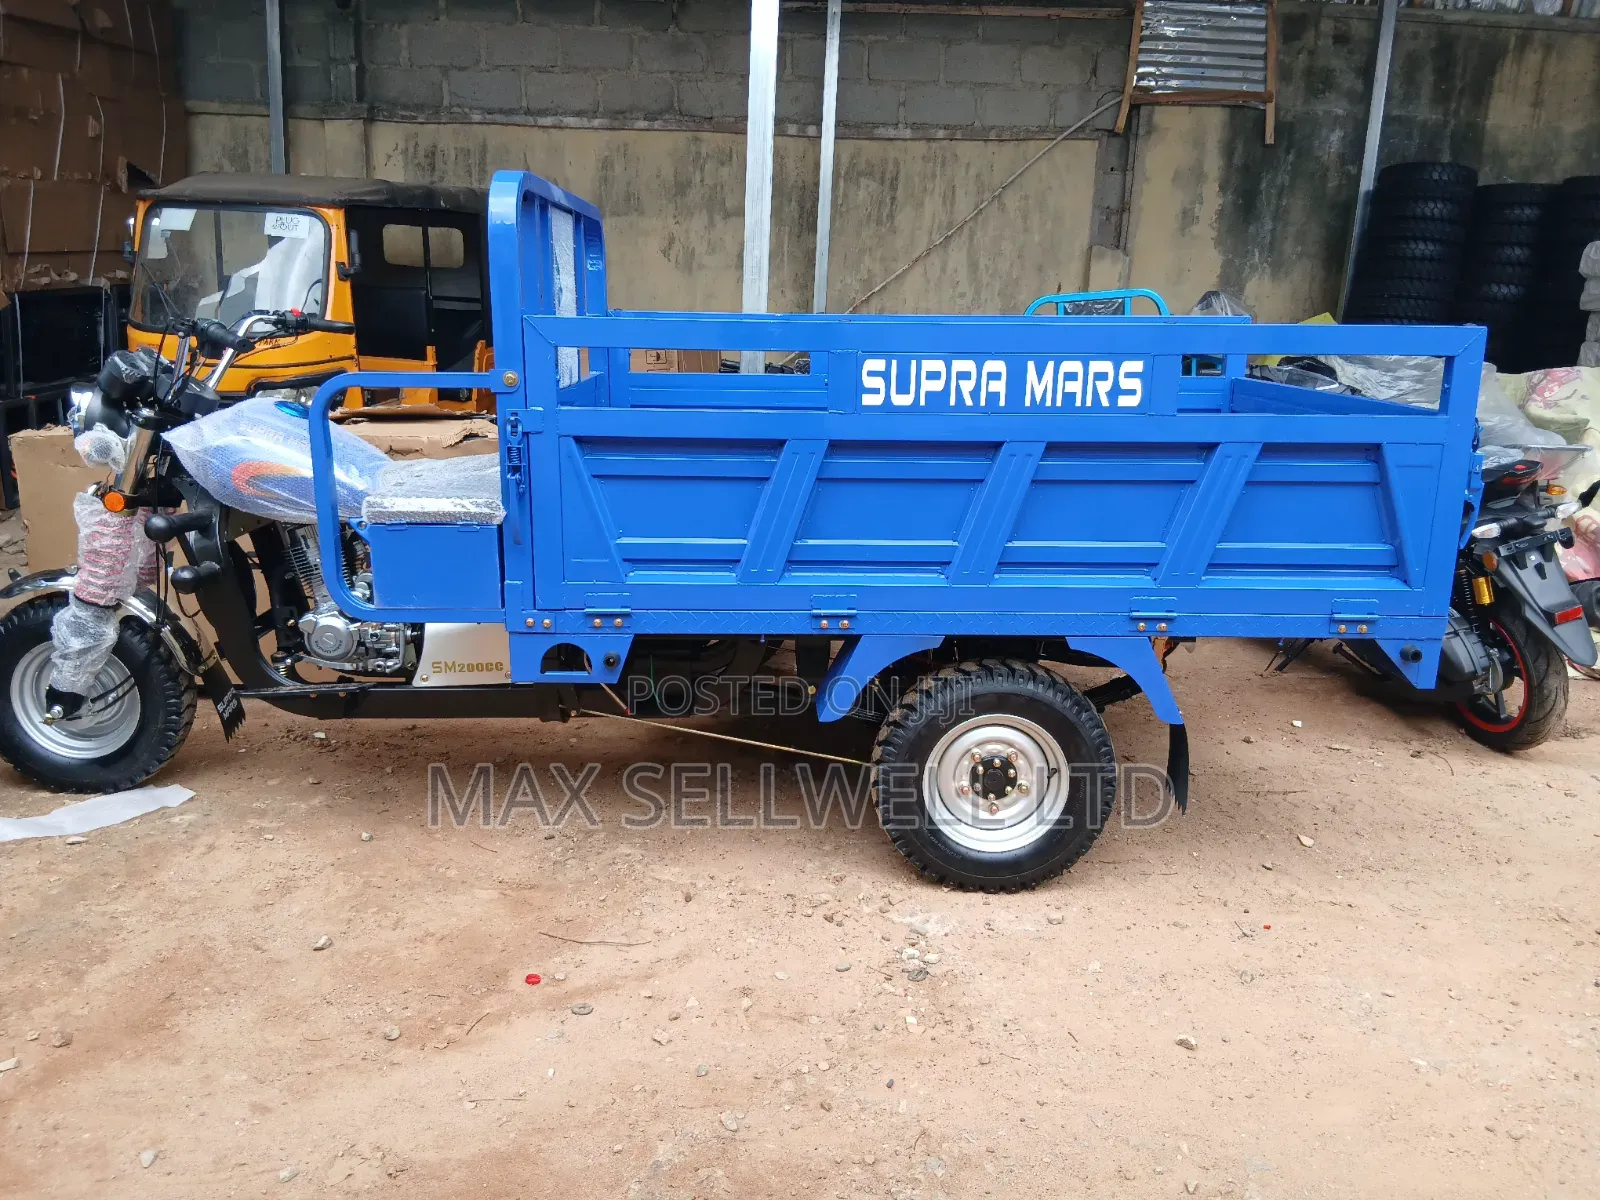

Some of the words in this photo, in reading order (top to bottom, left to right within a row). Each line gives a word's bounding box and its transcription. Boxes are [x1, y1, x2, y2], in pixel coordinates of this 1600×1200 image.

[862, 359, 1007, 406] SUPRA
[1025, 360, 1145, 407] MARS
[431, 660, 504, 674] SM200CC
